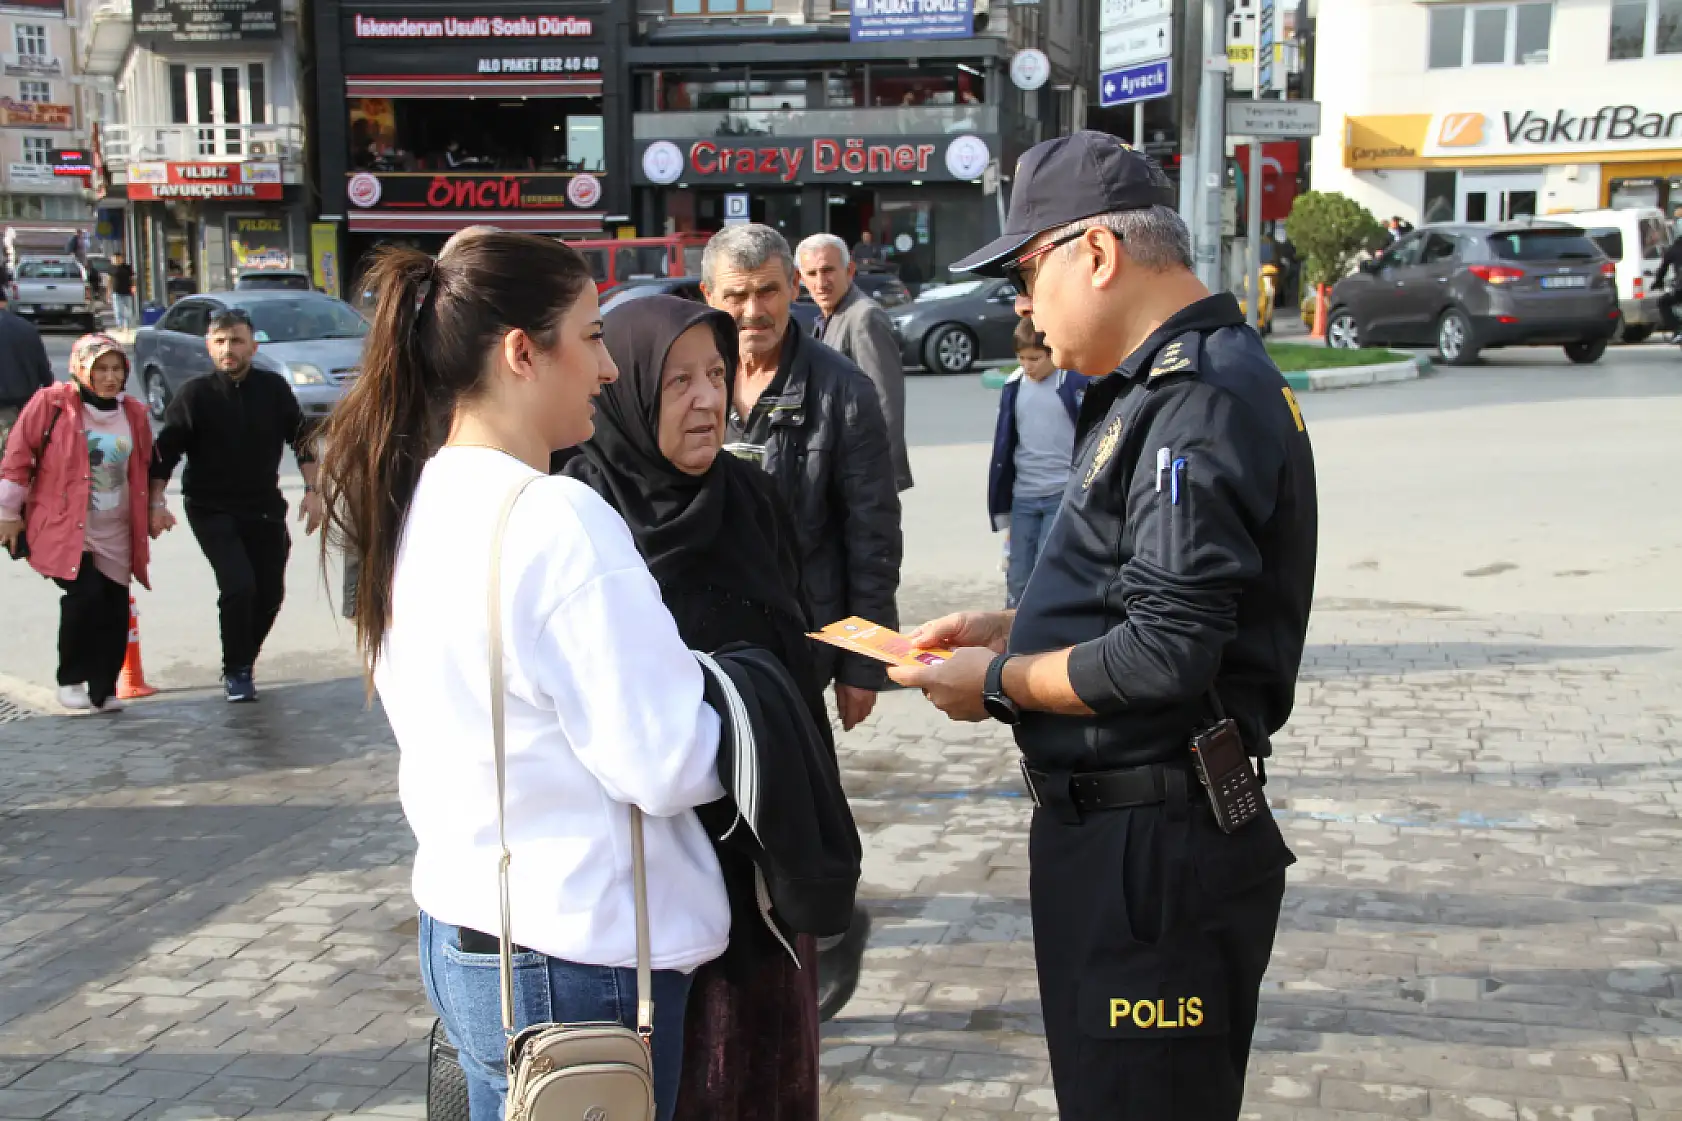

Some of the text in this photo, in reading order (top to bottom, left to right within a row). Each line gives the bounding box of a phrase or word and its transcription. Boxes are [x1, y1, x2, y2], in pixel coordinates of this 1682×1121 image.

[538, 16, 592, 36] Dürüm
[478, 58, 500, 72] ALO
[501, 58, 538, 72] PAKET
[563, 57, 580, 71] 40
[582, 56, 599, 70] 40
[1121, 69, 1164, 95] Ayvacık
[690, 139, 935, 182] Crazy Döner
[176, 165, 228, 178] YILDIZ
[152, 184, 256, 199] TAVUKÇULUK
[731, 199, 744, 214] D
